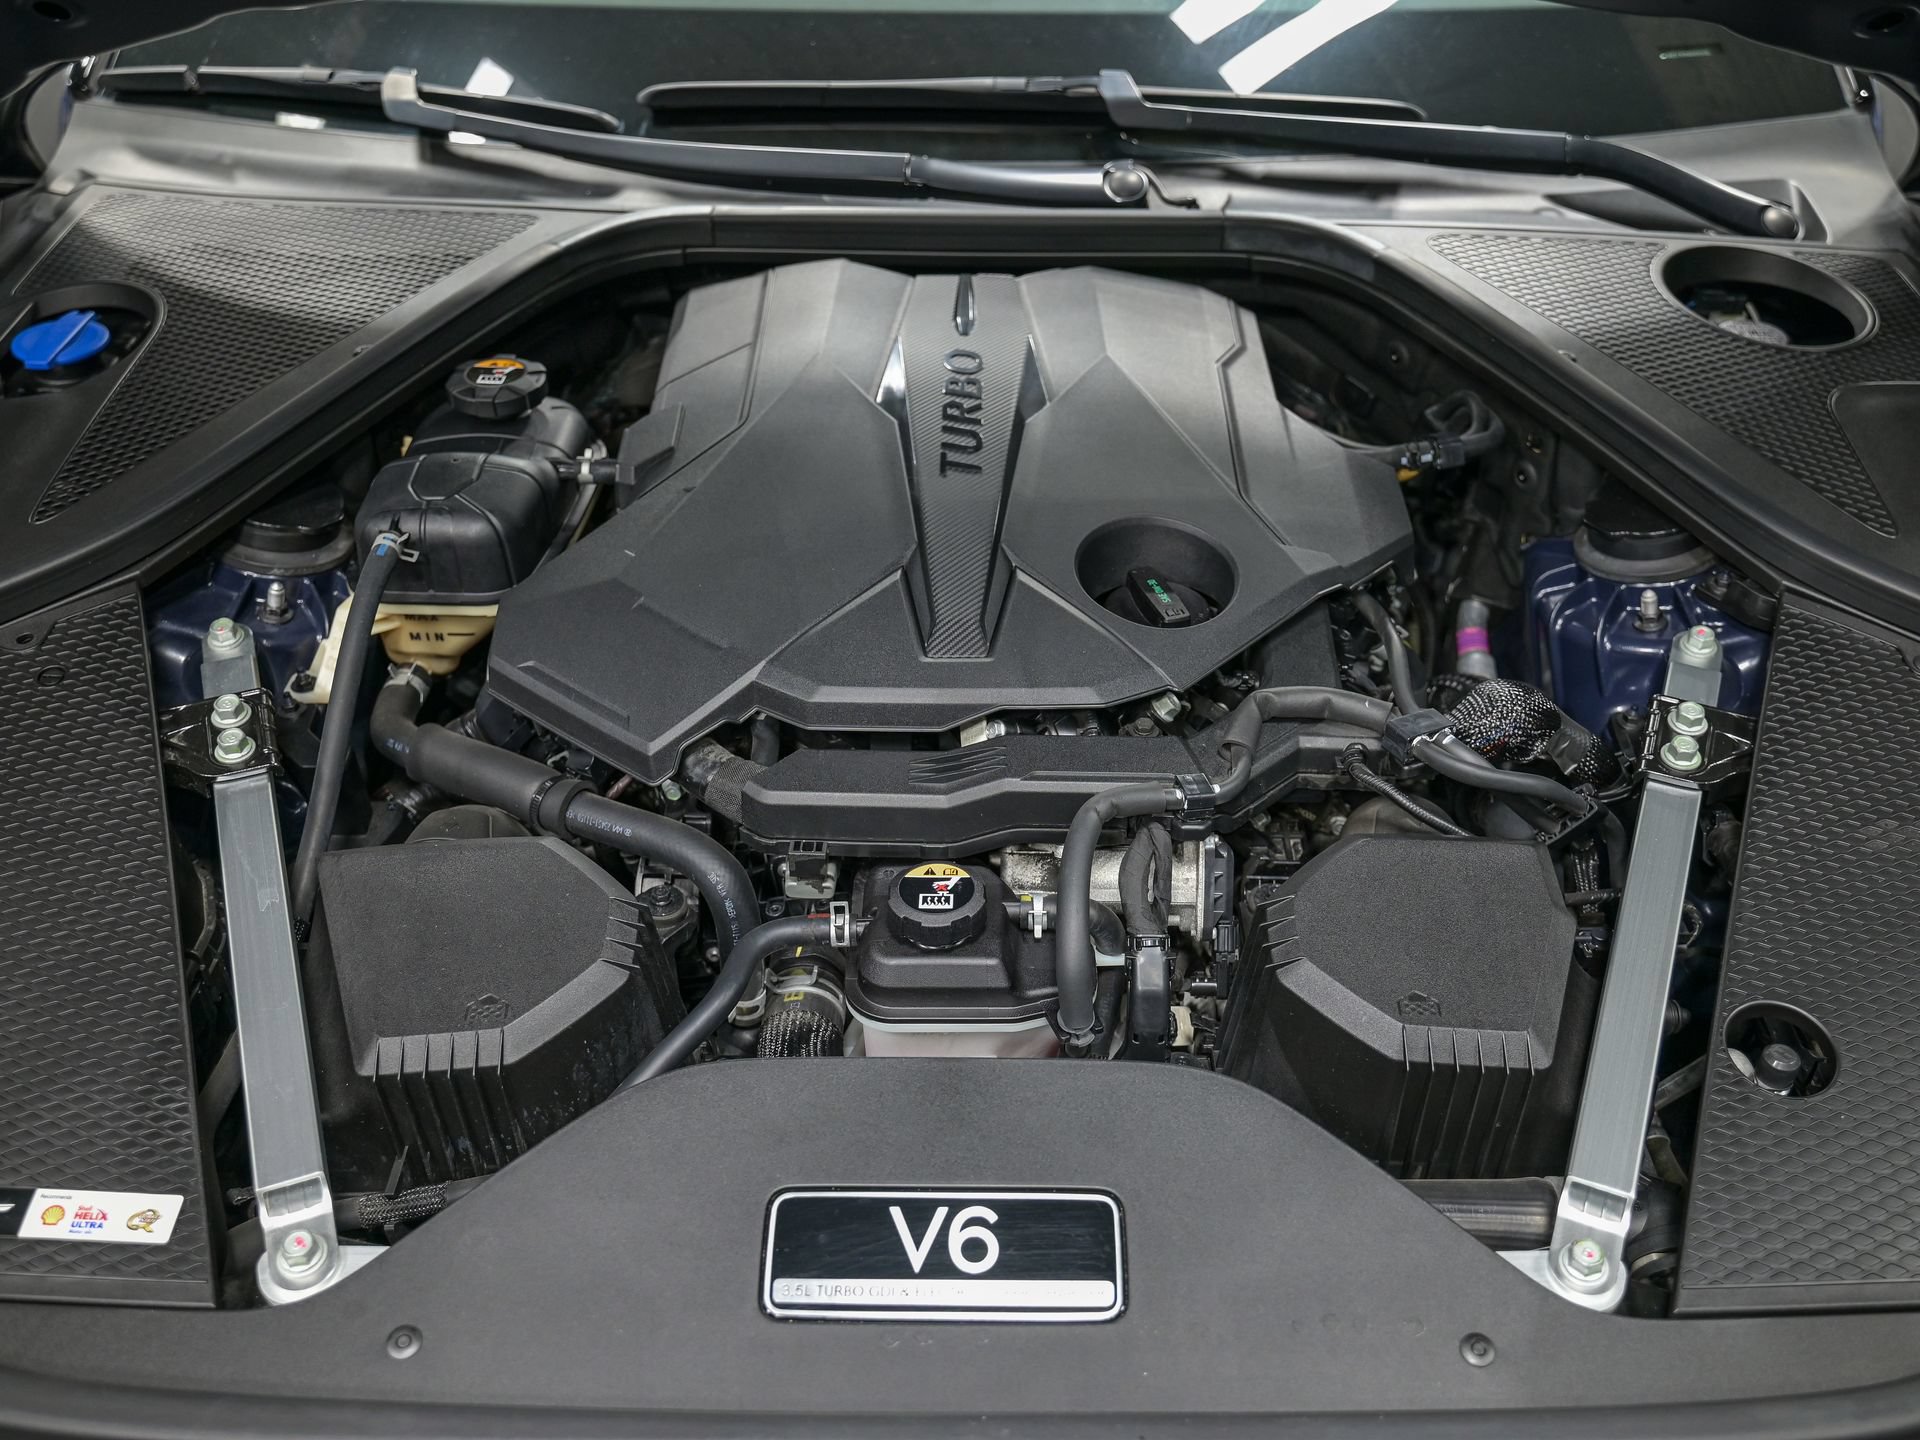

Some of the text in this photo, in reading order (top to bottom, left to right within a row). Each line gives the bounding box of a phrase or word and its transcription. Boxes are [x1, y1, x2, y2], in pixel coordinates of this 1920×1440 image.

[940, 348, 984, 478] TURBO
[409, 631, 445, 642] MIN
[71, 1221, 104, 1229] ULTRA
[888, 1205, 1000, 1275] V6
[781, 1284, 811, 1297] 3.5L
[816, 1284, 864, 1297] TURBO
